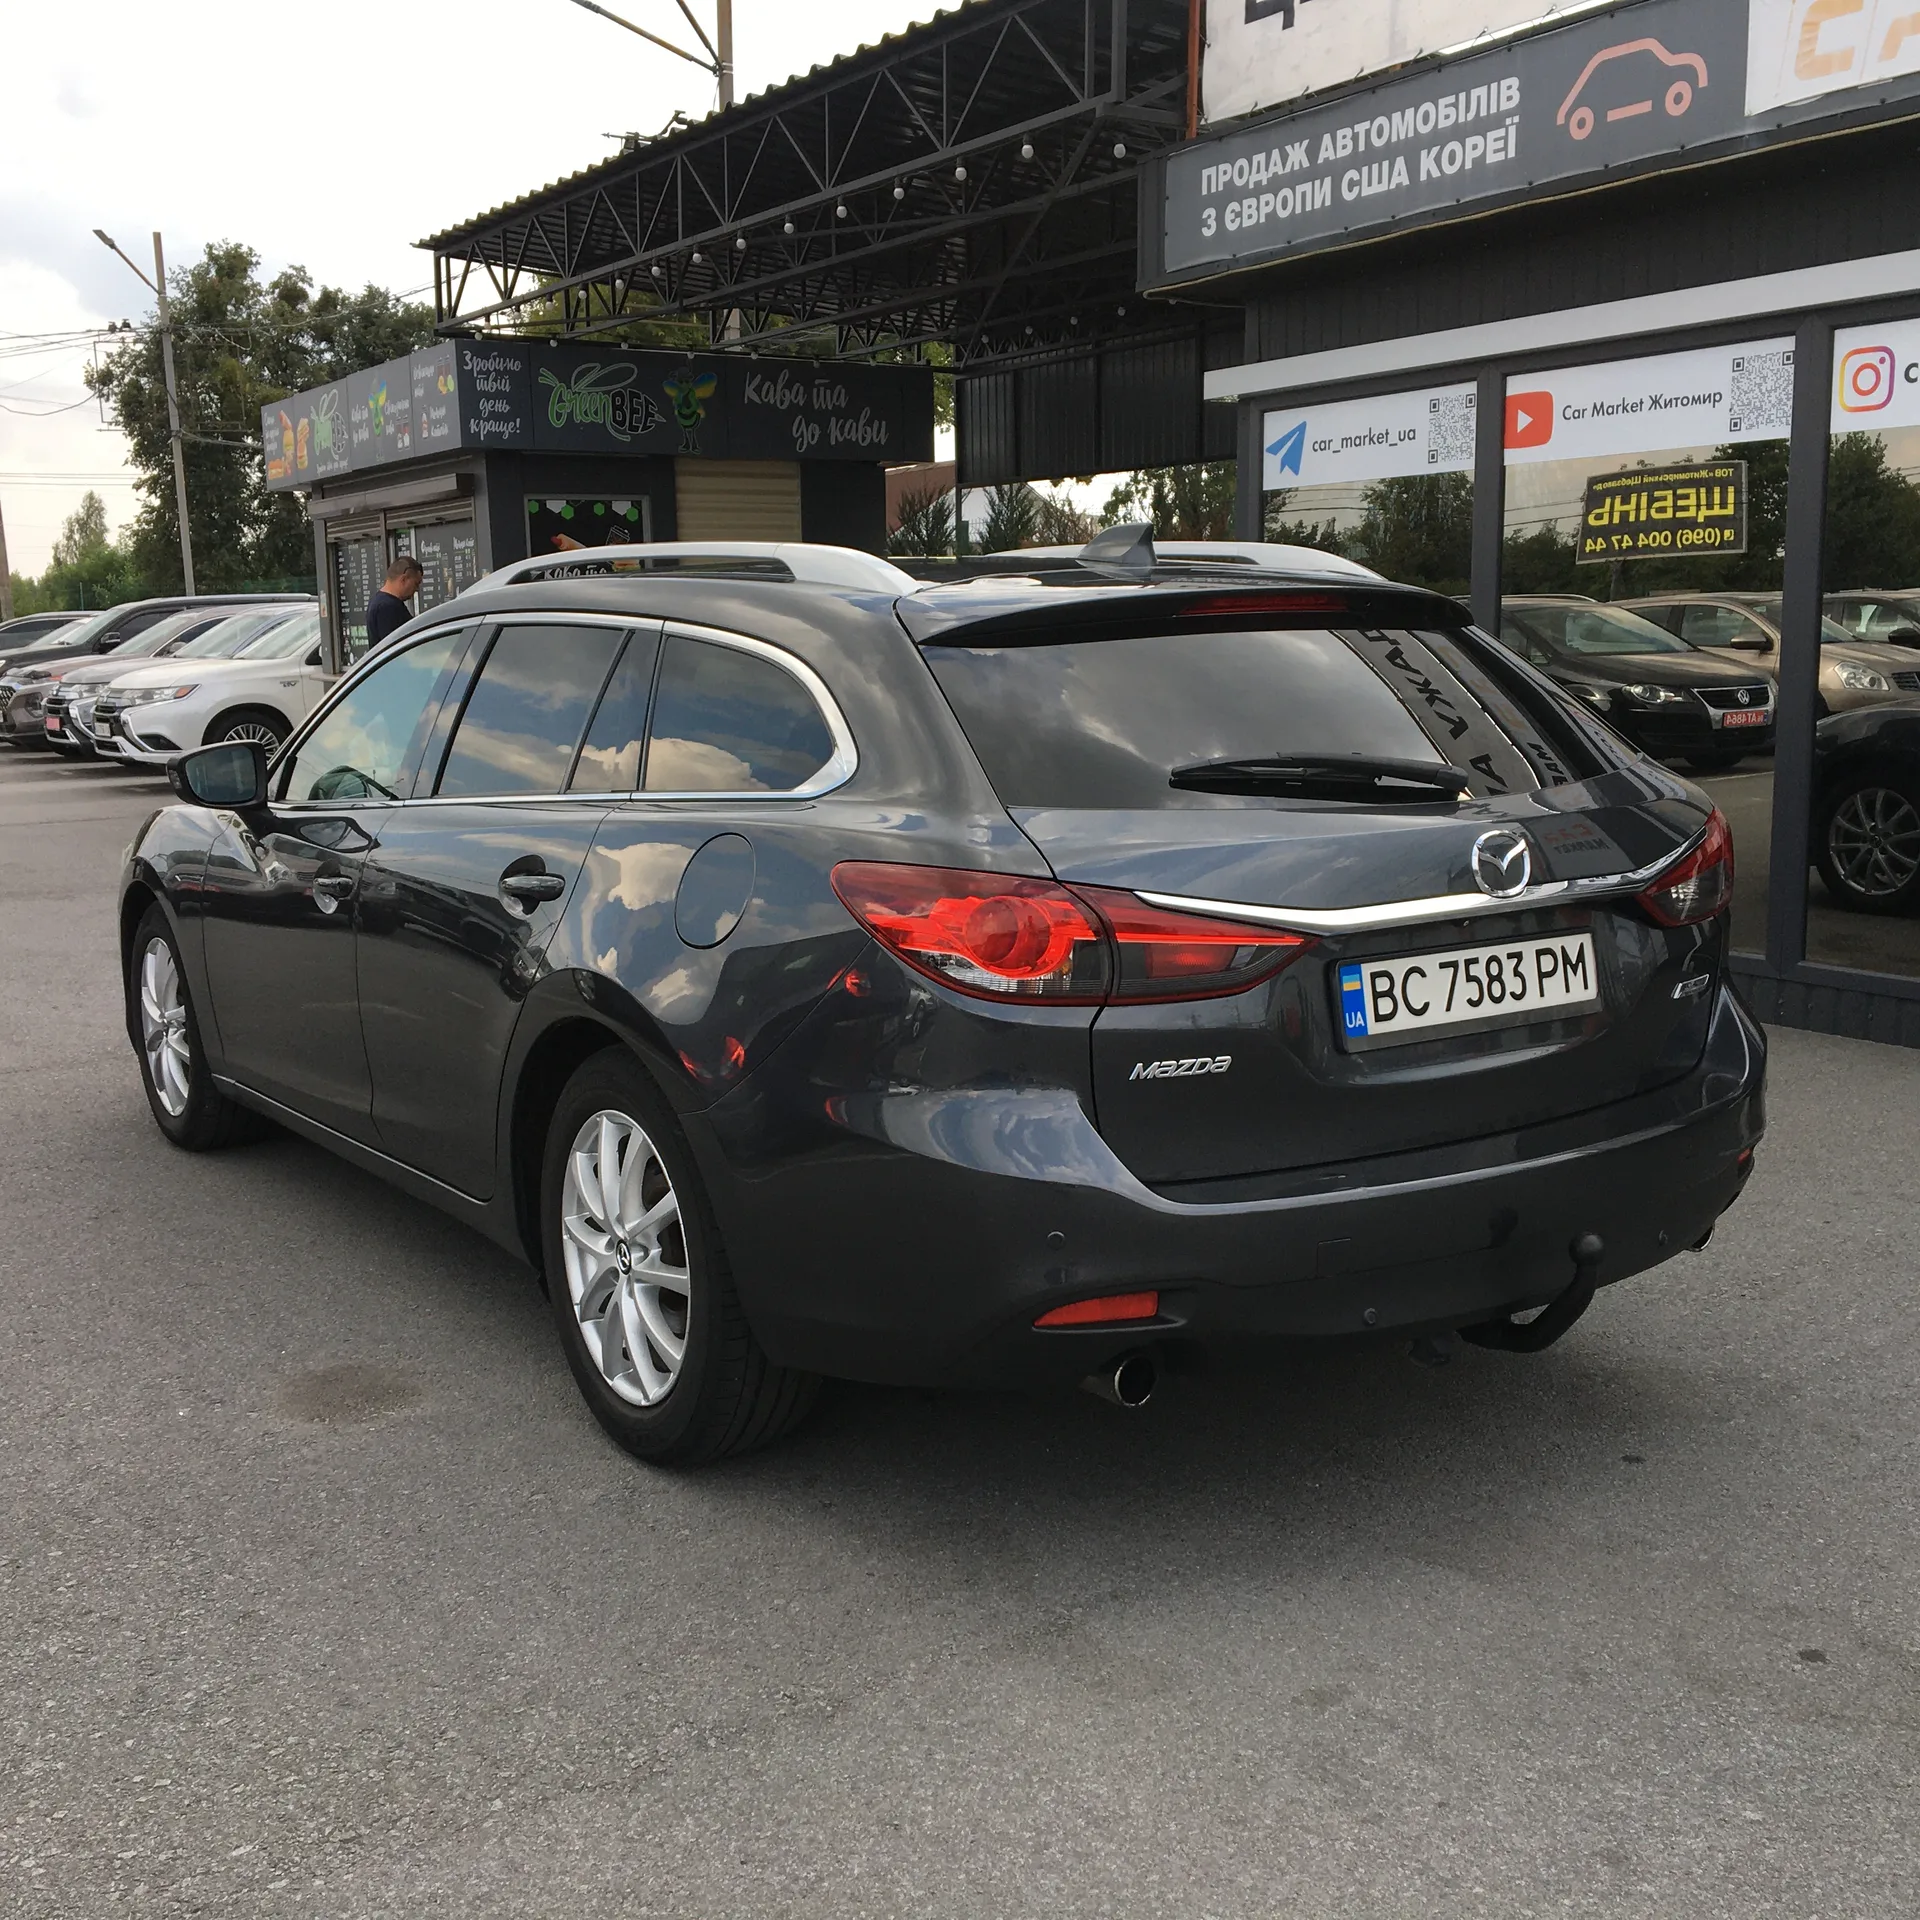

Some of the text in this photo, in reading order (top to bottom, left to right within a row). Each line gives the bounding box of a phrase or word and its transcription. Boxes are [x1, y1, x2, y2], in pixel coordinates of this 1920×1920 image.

[1201, 76, 1521, 196] ПРОДАЖ АВТОМОБІЛІВ
[1201, 115, 1520, 237] З ЄВРОПИ США КОРЕЇ
[463, 350, 522, 377] Зробимо
[476, 372, 512, 392] твій
[744, 369, 849, 410] Кава та
[479, 399, 510, 417] день
[1562, 391, 1723, 421] Car Market Житомир
[469, 418, 521, 440] краще!
[792, 406, 890, 453] до кави
[1312, 425, 1417, 454] car_market_ua
[1369, 942, 1589, 1023] BC 7583 PM
[1345, 1012, 1365, 1029] UA
